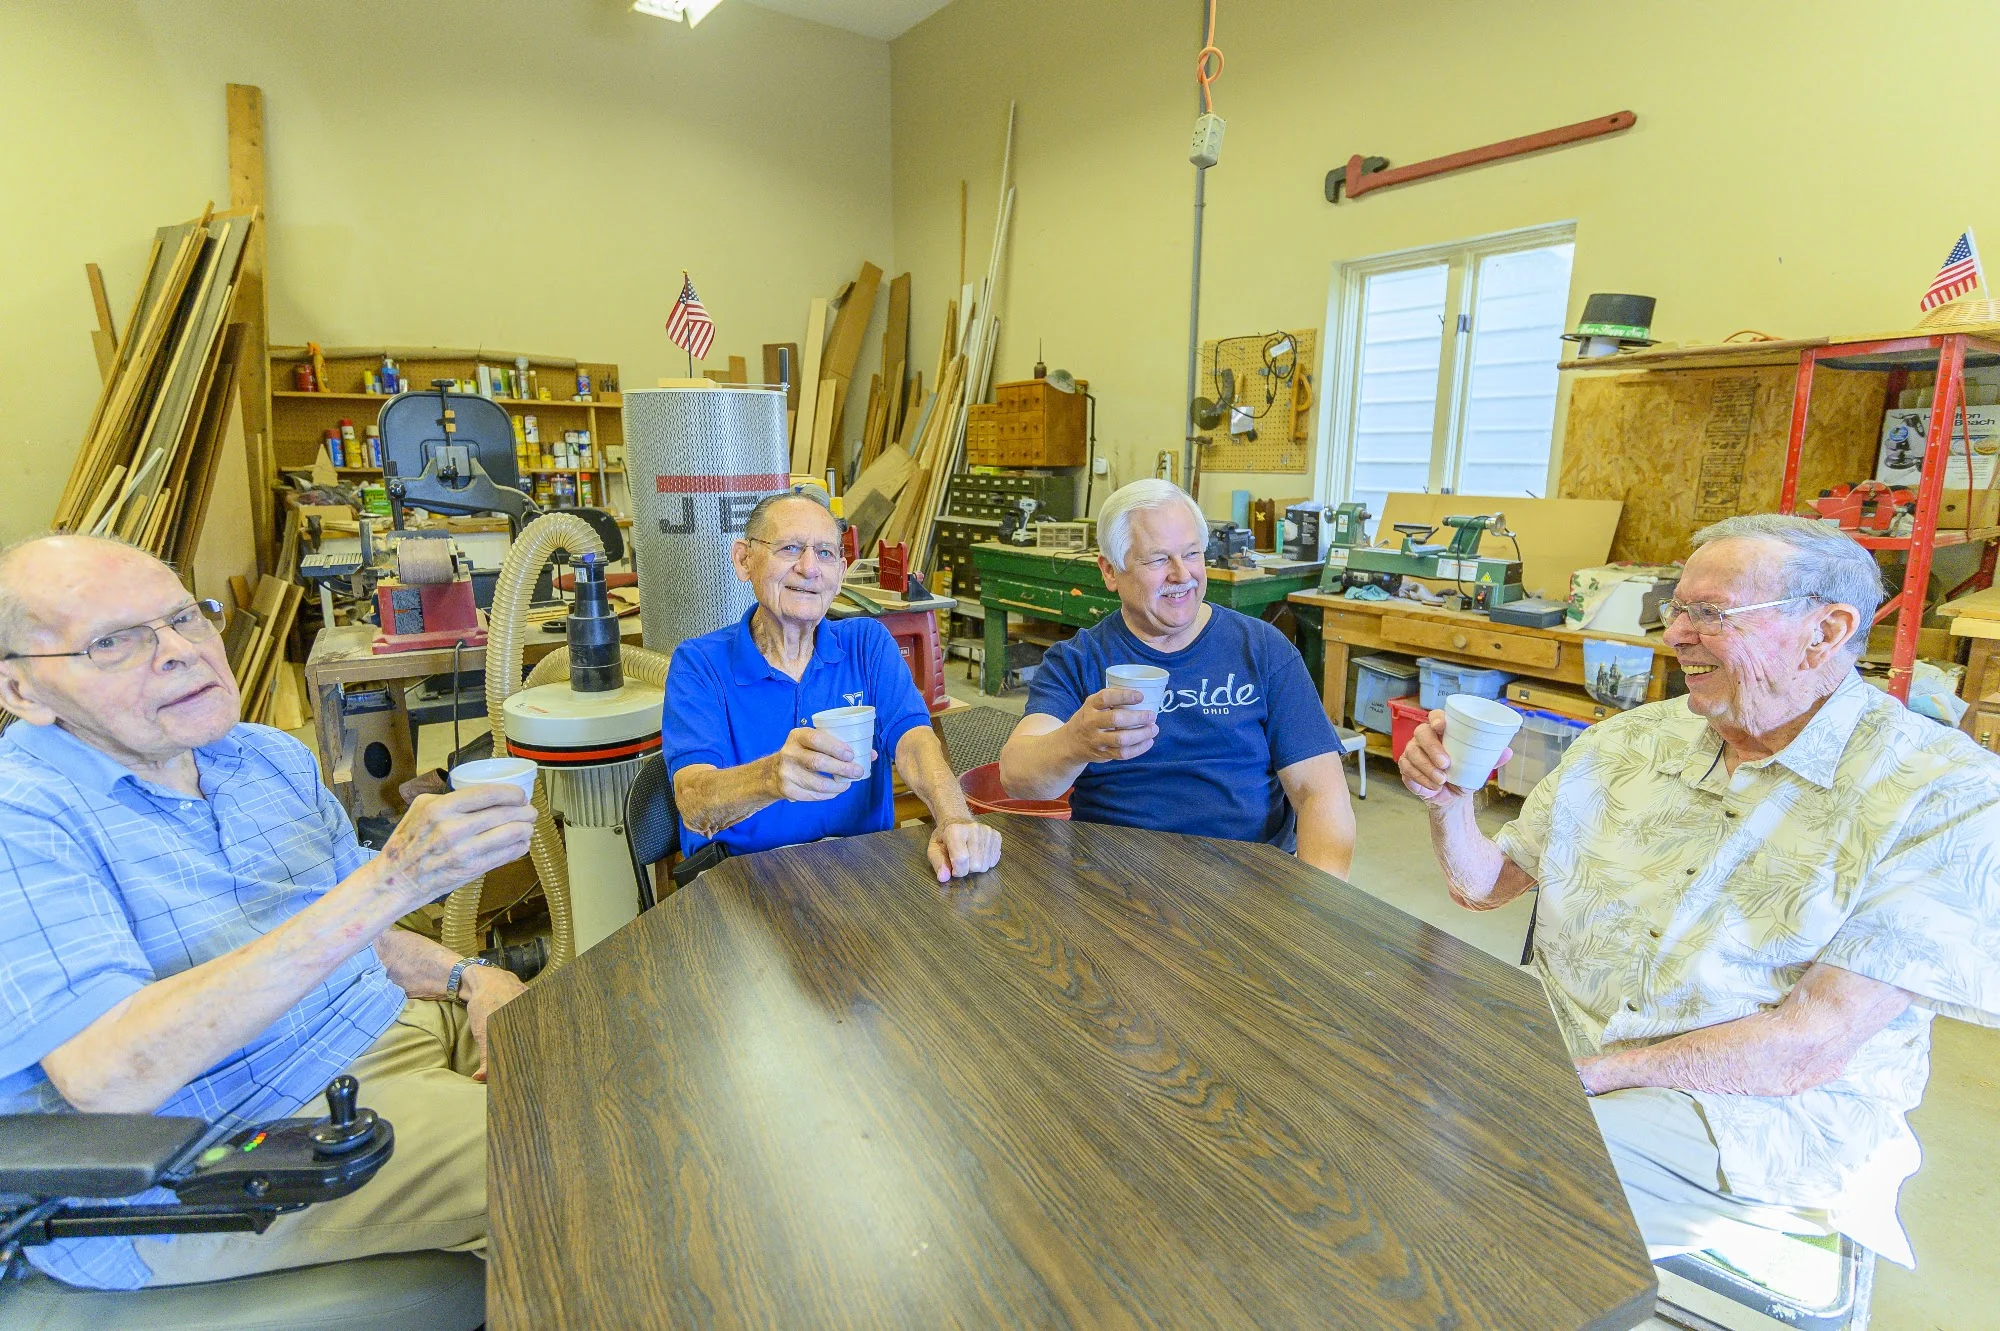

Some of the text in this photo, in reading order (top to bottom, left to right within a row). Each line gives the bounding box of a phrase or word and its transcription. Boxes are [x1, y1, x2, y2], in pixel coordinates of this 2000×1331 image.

[660, 496, 758, 534] JE
[1159, 673, 1261, 714] eside
[1202, 707, 1230, 715] OHIO
